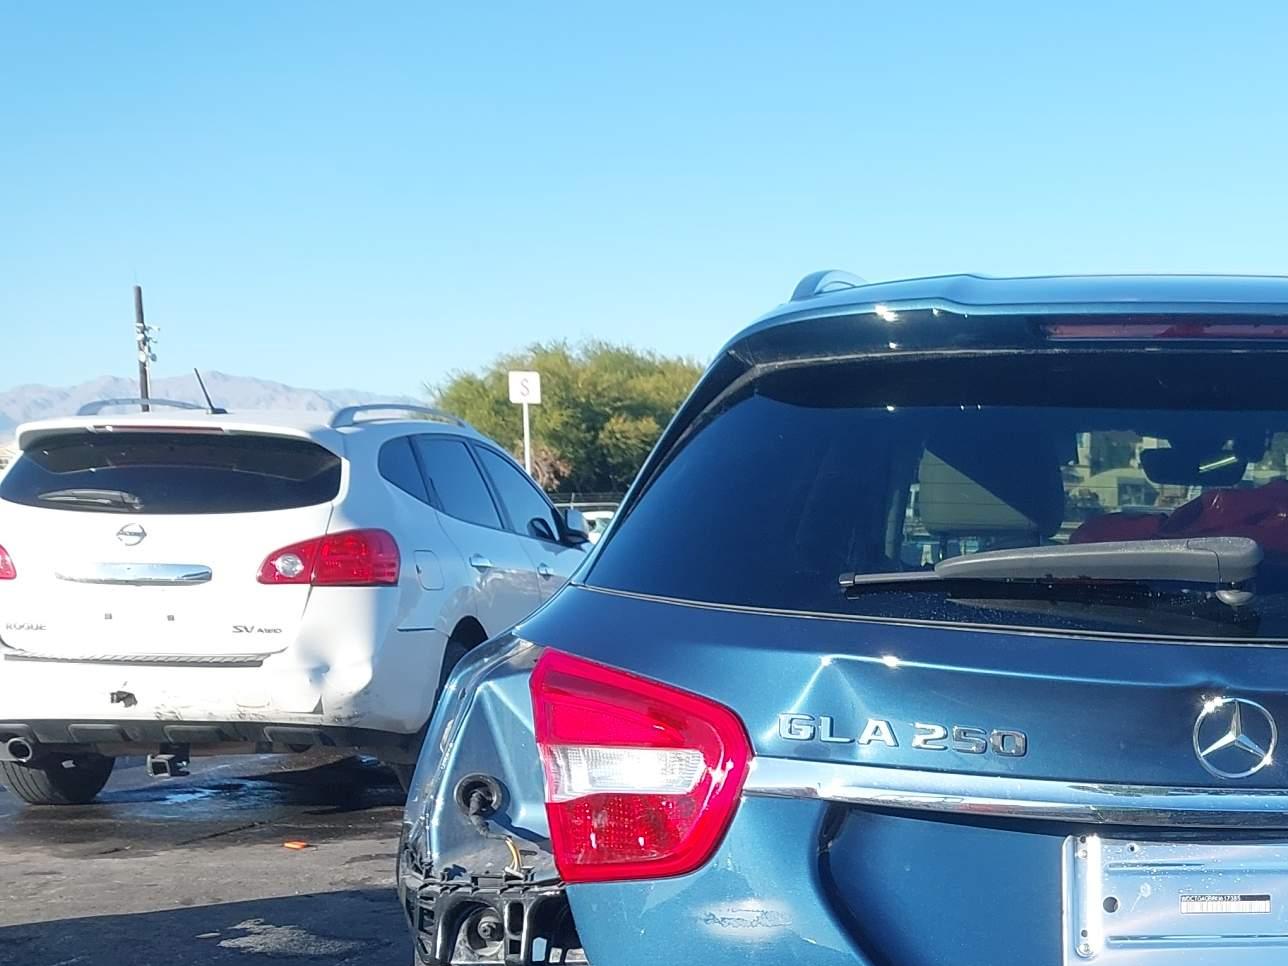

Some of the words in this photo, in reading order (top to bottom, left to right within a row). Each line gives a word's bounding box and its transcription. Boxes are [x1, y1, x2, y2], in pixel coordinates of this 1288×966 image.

[232, 625, 254, 634] SV
[777, 712, 899, 748] GLA
[911, 721, 1028, 757] 250
